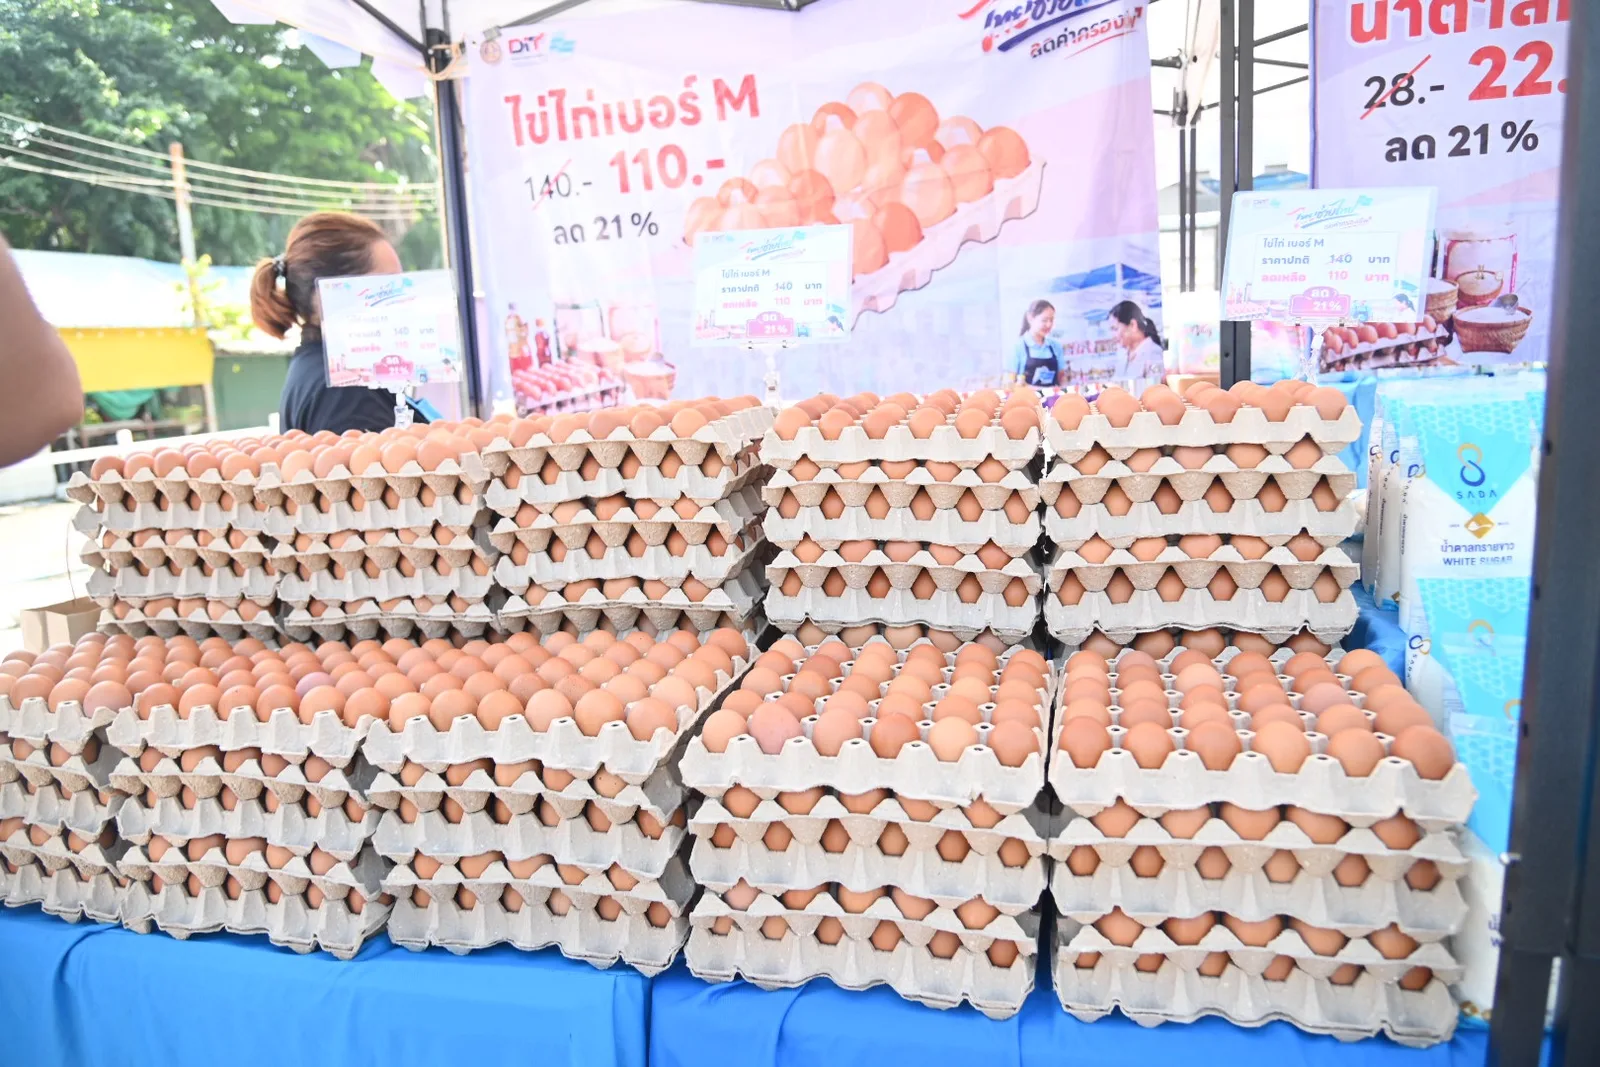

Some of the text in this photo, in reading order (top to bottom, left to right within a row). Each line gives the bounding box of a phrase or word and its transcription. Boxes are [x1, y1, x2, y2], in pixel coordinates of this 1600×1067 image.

[504, 74, 760, 146] ไข่ไก่เบอร์ M
[1384, 119, 1539, 162] ลด 21 %
[609, 144, 725, 194] 110.-
[554, 211, 659, 245] ลด 21 %
[1263, 237, 1324, 249] ไข่ไก่ เบอร์ M
[1261, 254, 1390, 265] ราคาปกติ 140 บาท
[1261, 270, 1390, 283] ลดเหลือ 110 บาท
[774, 282, 793, 291] 140
[805, 282, 822, 290] บาท
[1456, 489, 1498, 500] SADA
[1443, 557, 1477, 566] WHITE
